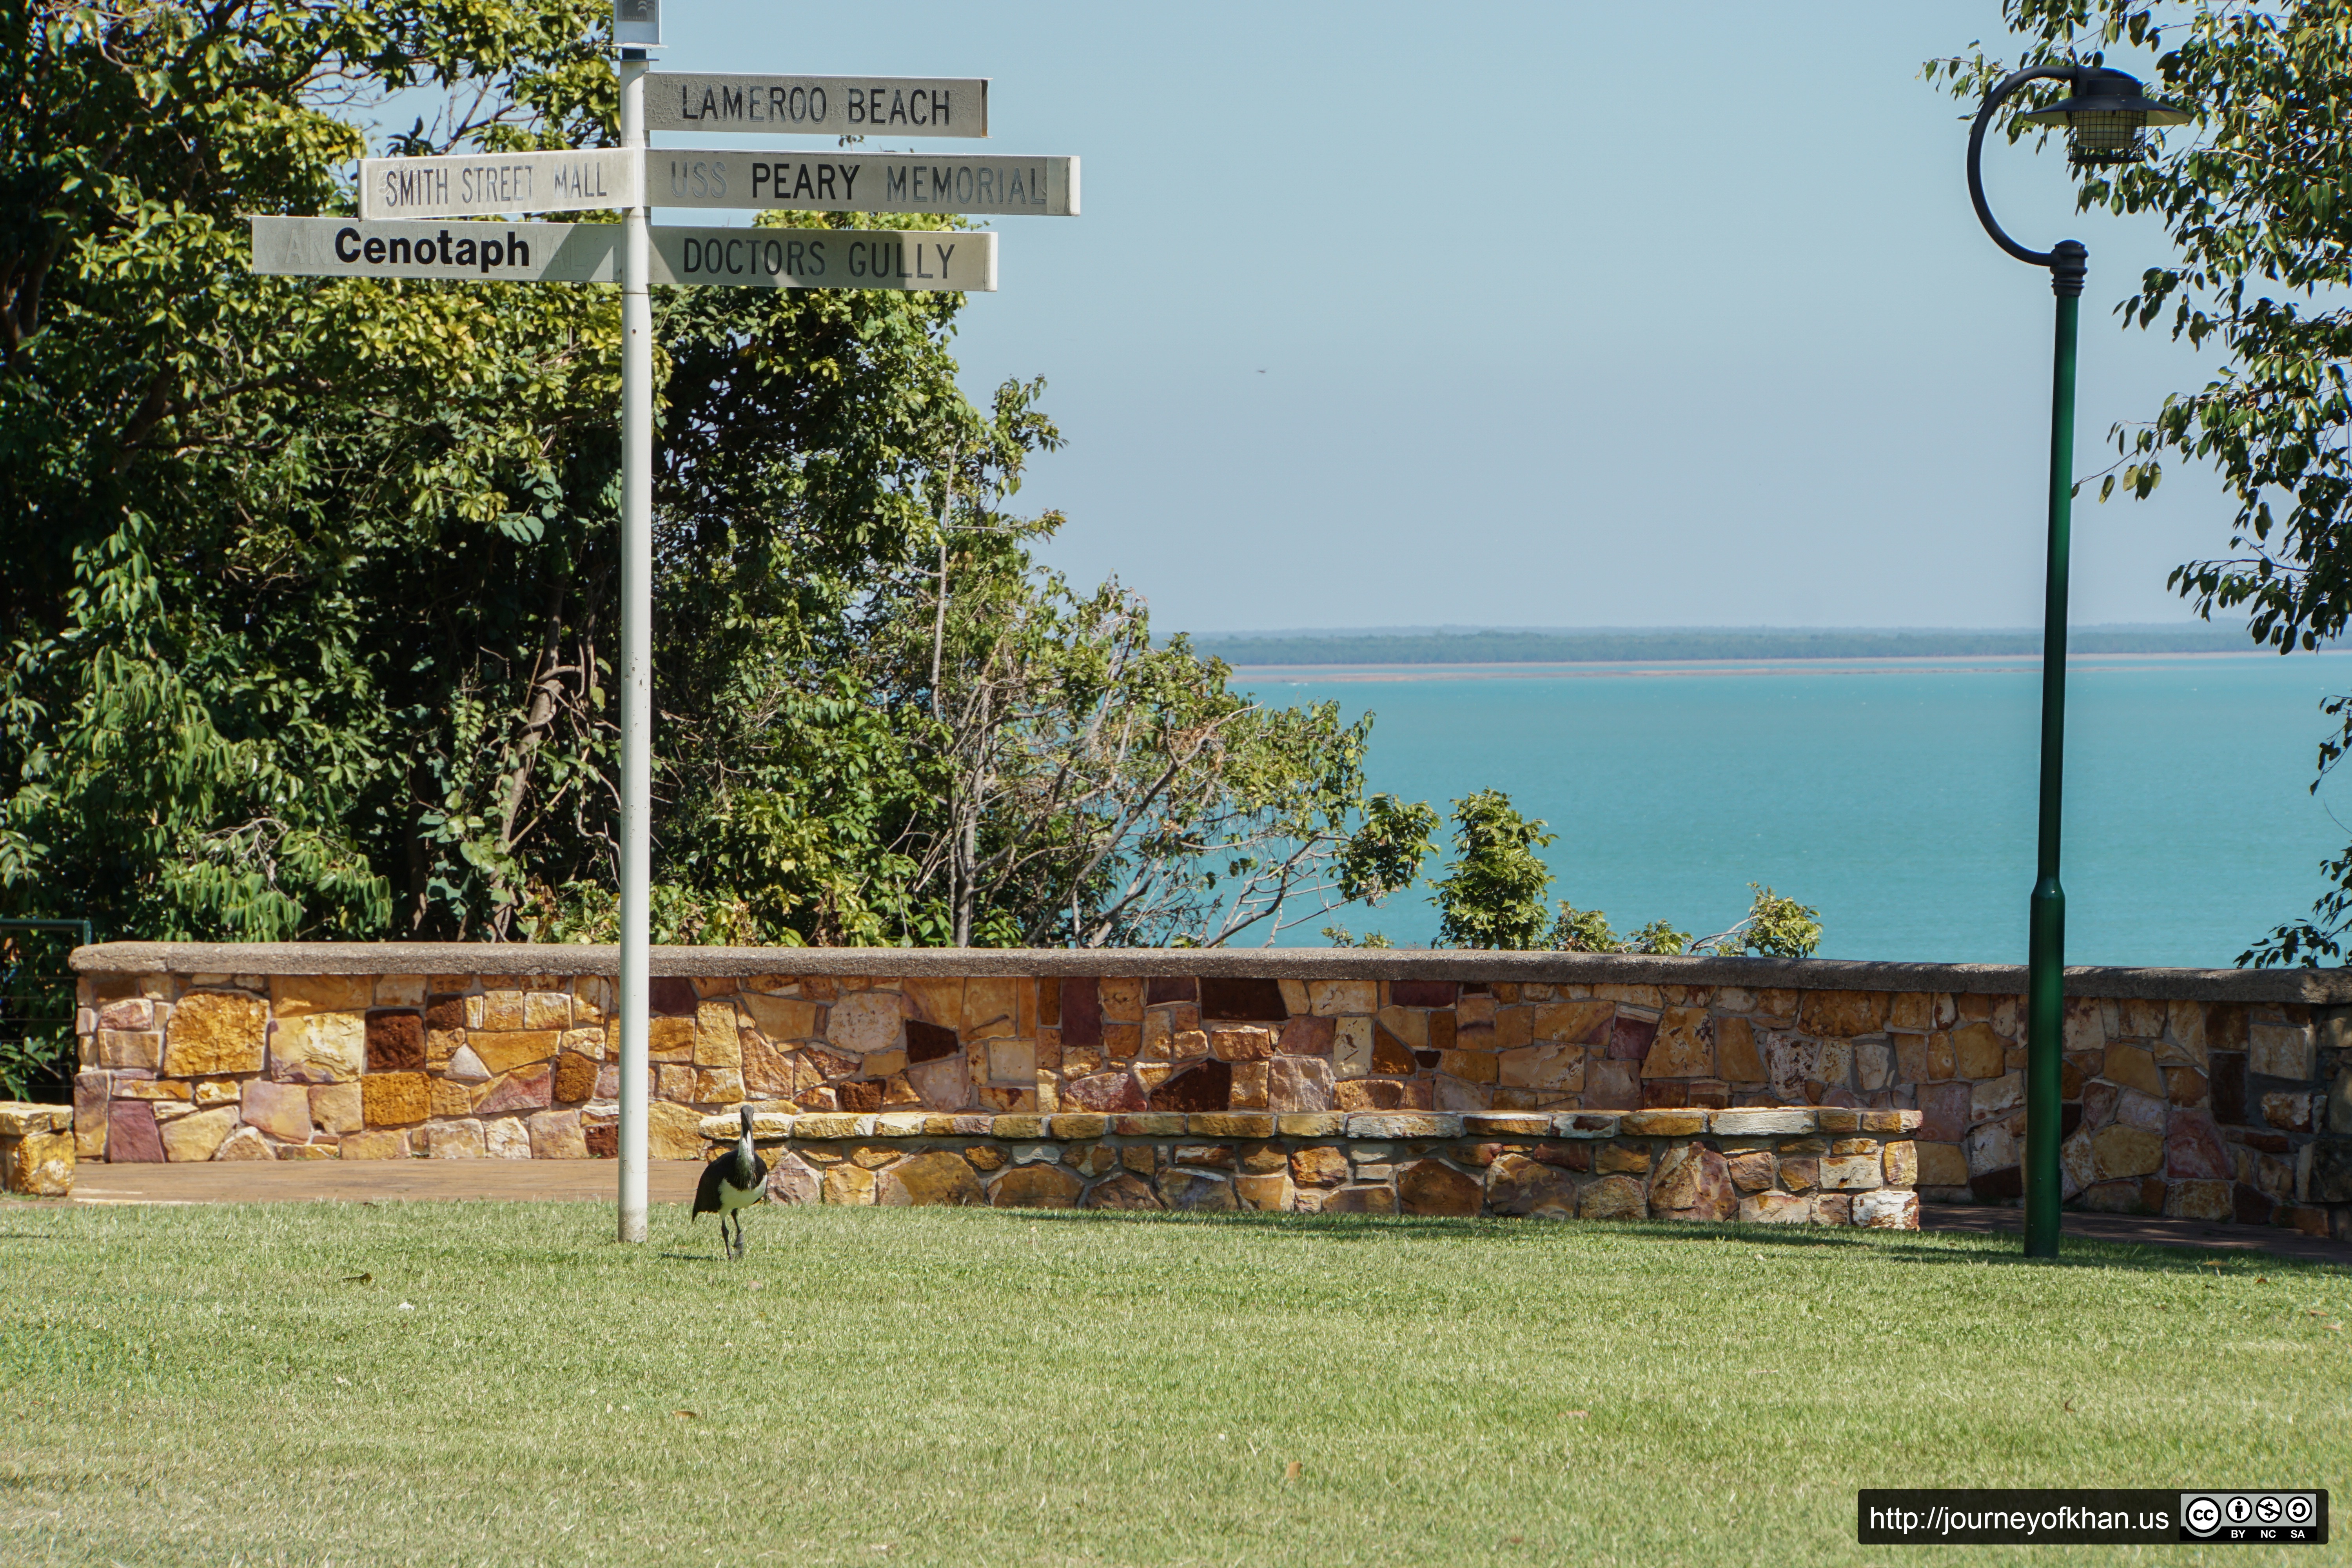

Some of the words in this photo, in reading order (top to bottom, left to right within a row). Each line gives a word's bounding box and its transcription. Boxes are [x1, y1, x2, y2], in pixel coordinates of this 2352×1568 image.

[682, 84, 827, 123] LAMEROO
[848, 88, 949, 125] BEACH
[386, 168, 448, 207] SMITH
[462, 165, 534, 203] STREET
[554, 162, 607, 198] MALL
[671, 161, 727, 198] USS
[752, 163, 860, 200] PEARY
[887, 165, 1047, 205] MEMORIAL
[335, 227, 529, 273] Cenotaph
[684, 238, 826, 275] DOCTORS
[848, 241, 955, 279] GULLY
